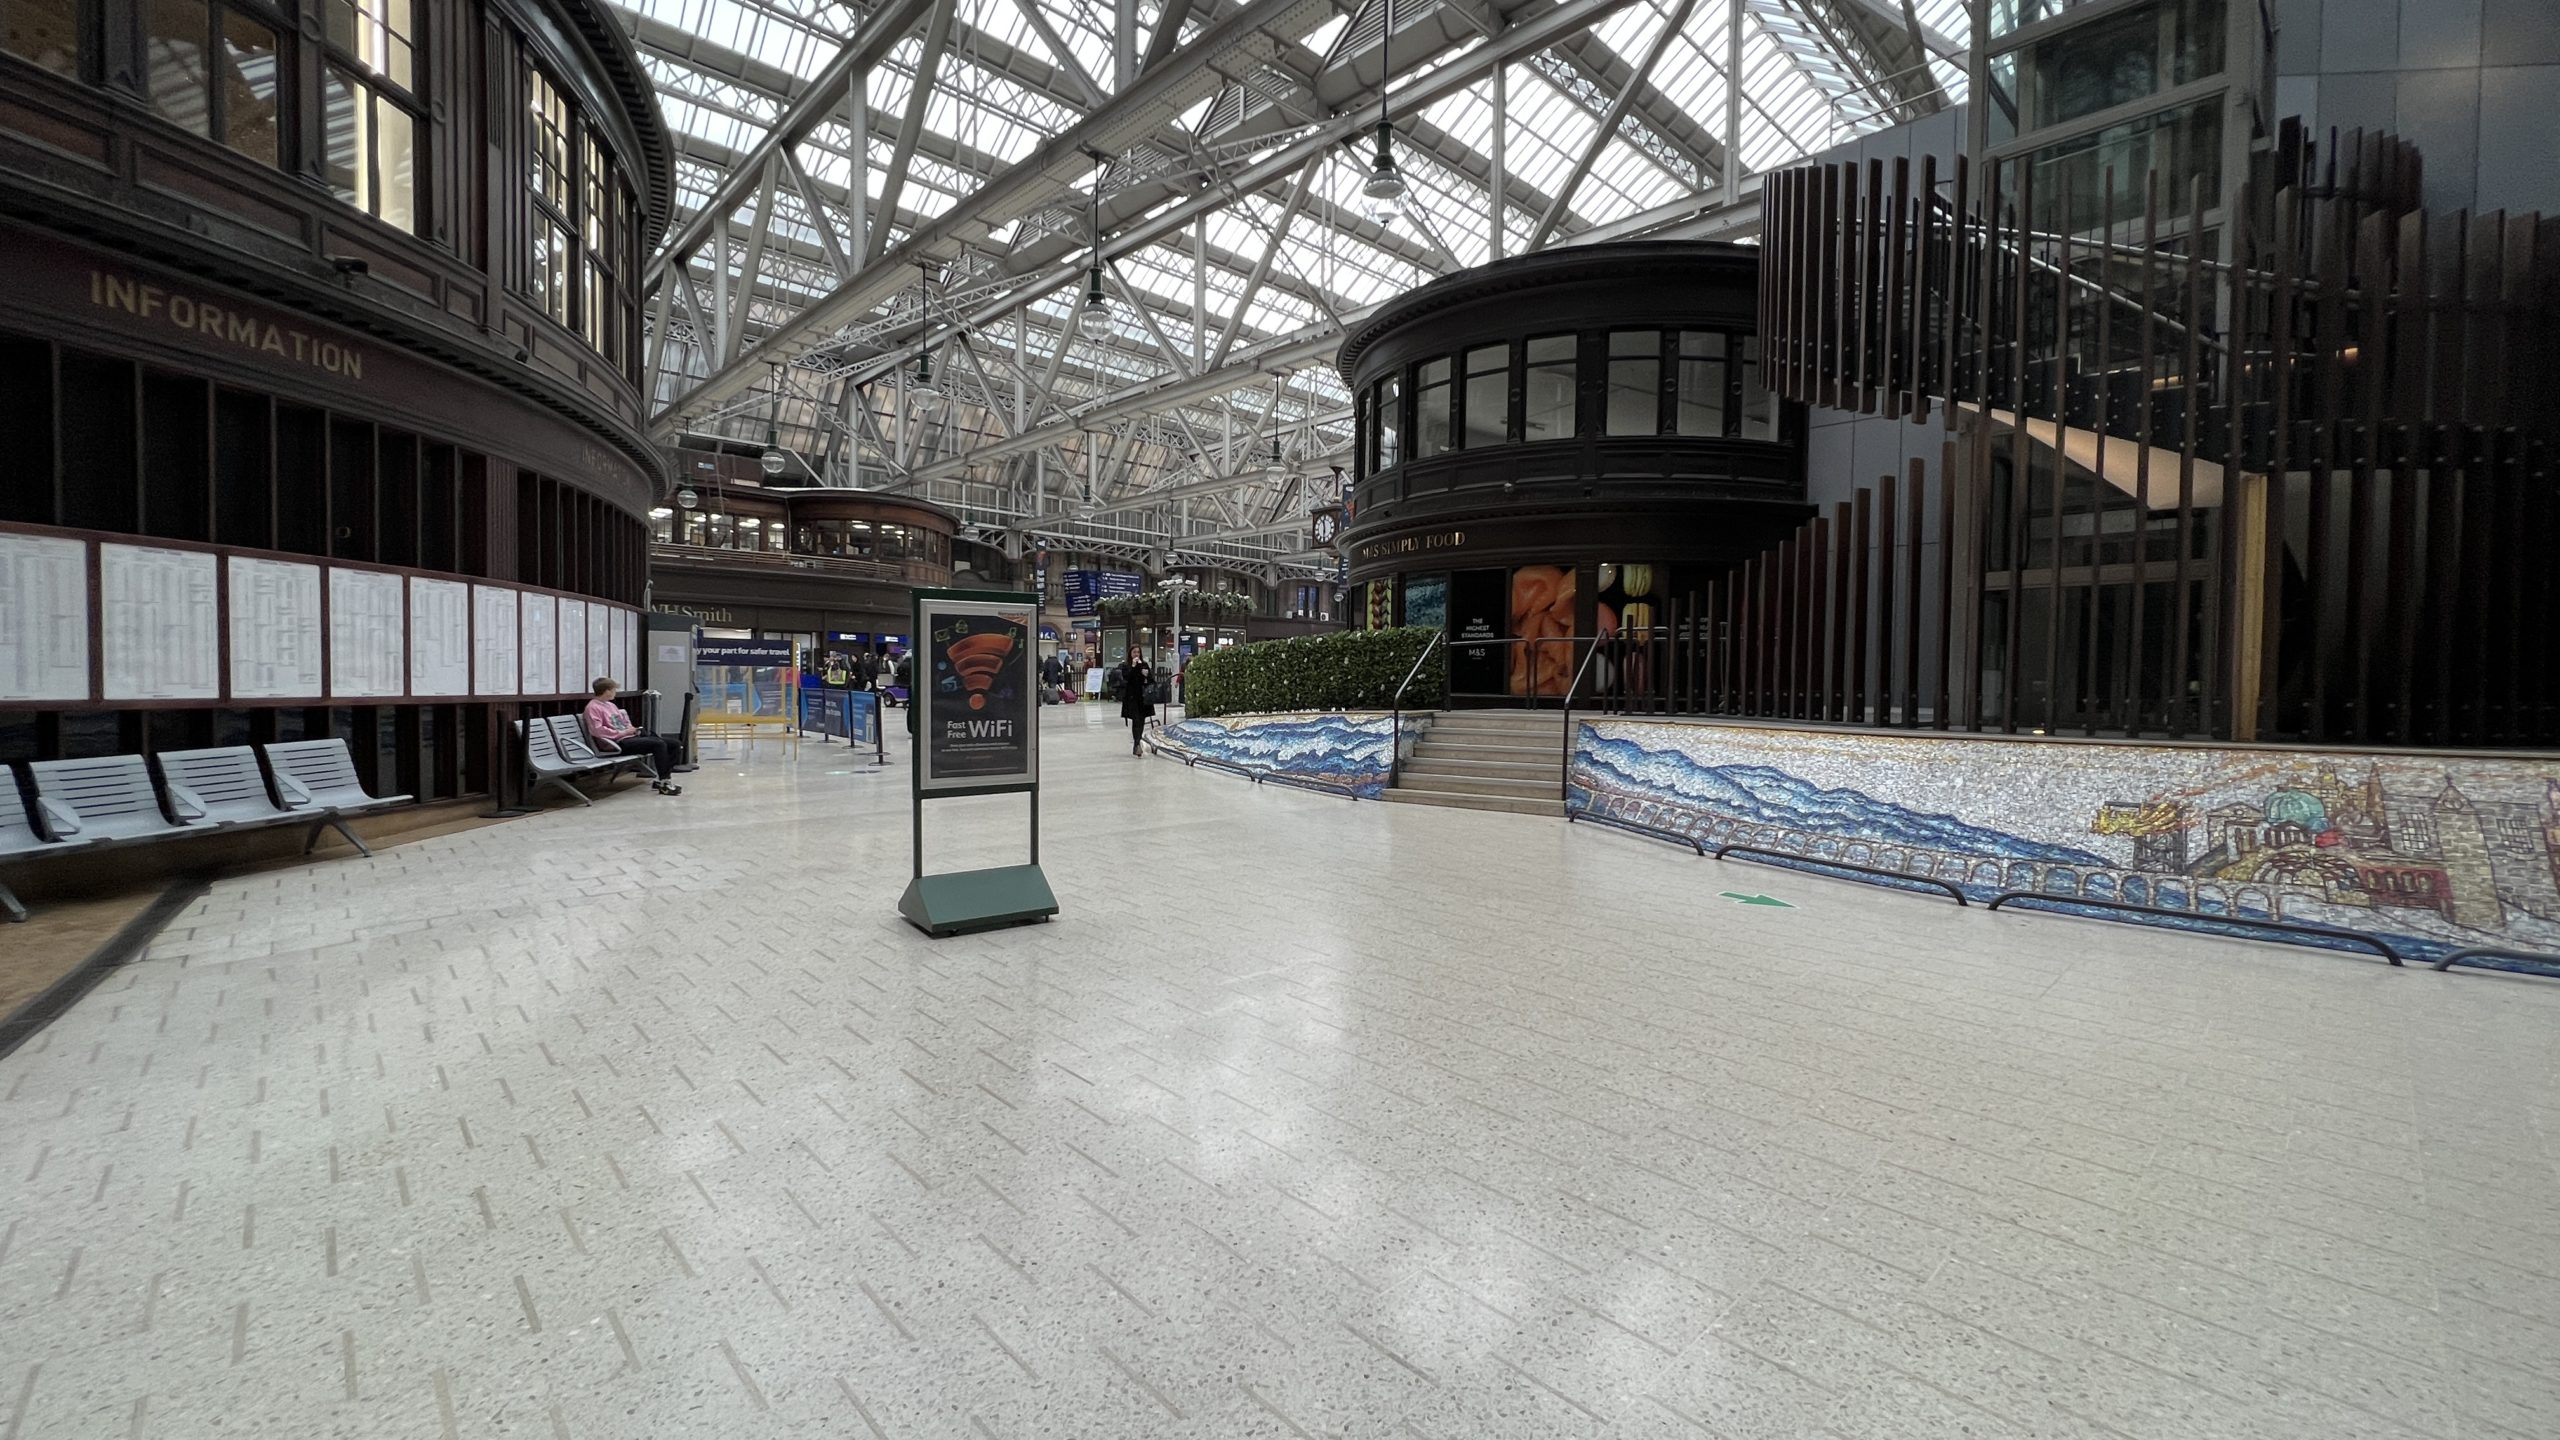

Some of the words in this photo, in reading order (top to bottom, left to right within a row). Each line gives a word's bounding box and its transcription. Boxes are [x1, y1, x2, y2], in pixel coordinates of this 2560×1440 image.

[91, 271, 363, 380] INFORMATION
[1381, 537, 1420, 554] SIMPLY
[1426, 532, 1465, 549] FOOD
[703, 648, 720, 656] your
[738, 647, 748, 655] for
[769, 648, 790, 656] travel
[1468, 648, 1485, 656] M&S
[947, 720, 966, 729] Fast
[968, 719, 1013, 738] WiFi
[947, 730, 967, 739] Free
